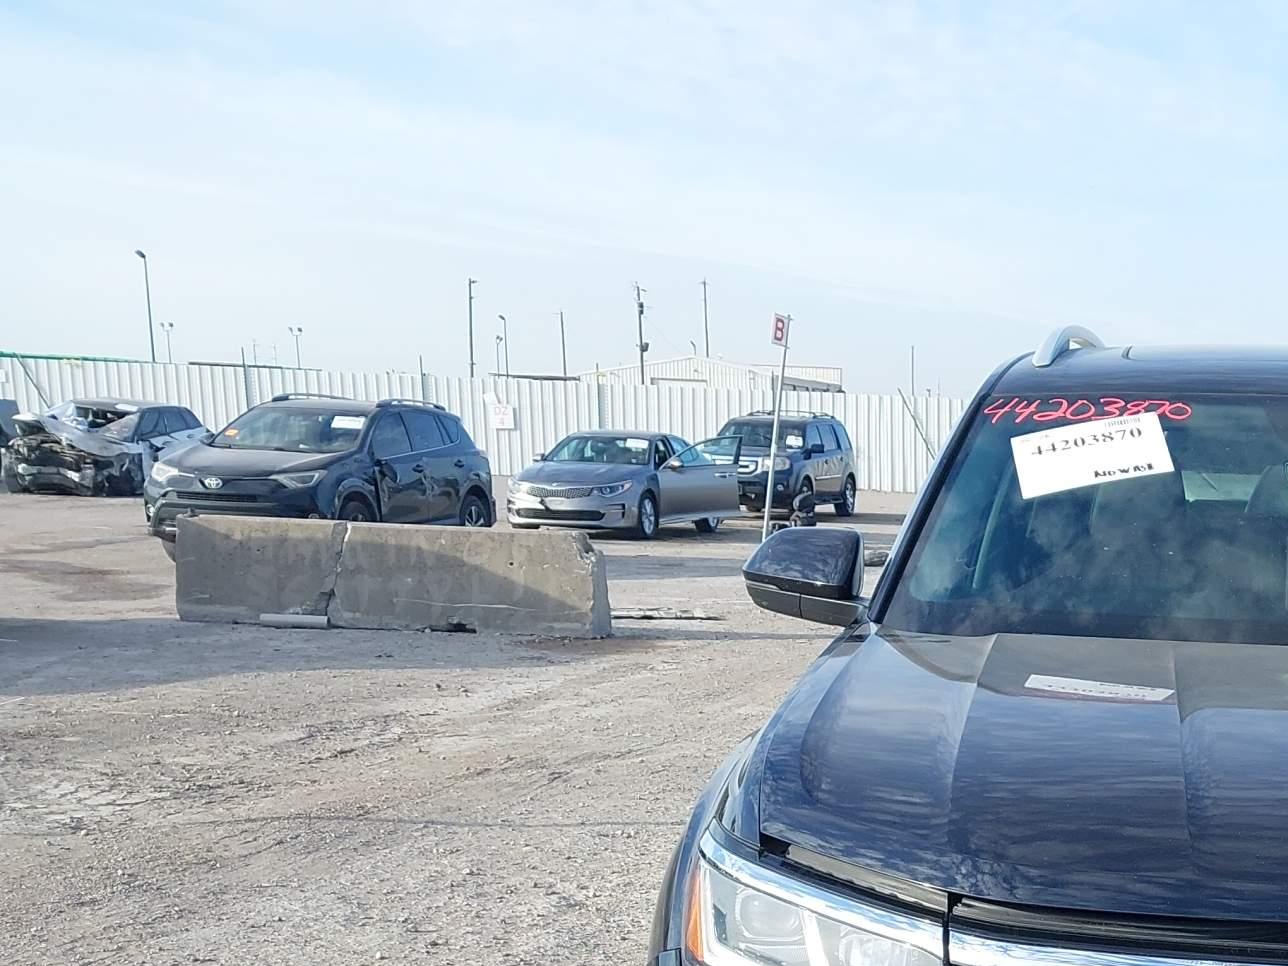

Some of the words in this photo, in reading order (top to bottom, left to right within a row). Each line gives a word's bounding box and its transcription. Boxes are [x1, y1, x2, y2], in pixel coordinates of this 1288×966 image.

[774, 317, 785, 342] B
[984, 397, 1192, 424] 44203870
[1031, 426, 1143, 456] 44203870
